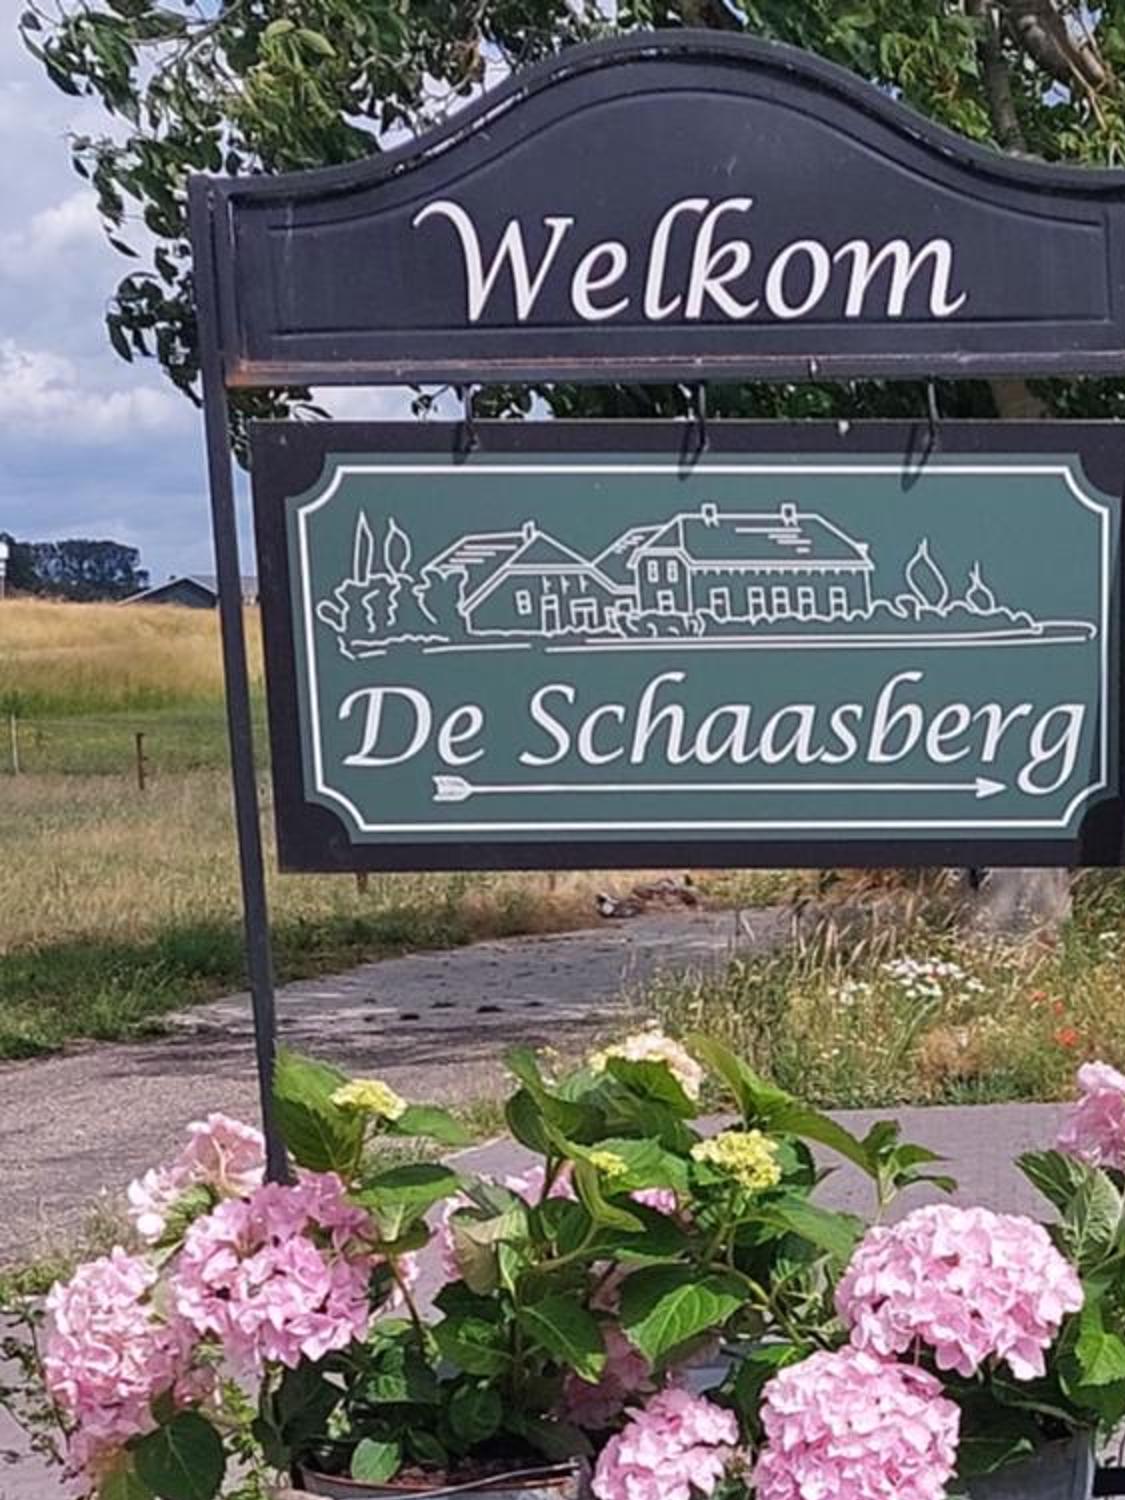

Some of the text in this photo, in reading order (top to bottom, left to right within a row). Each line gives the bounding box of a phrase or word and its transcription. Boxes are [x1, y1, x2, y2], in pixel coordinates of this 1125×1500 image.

[412, 198, 967, 321] Welkom
[338, 671, 1087, 796] De Schaasberg
